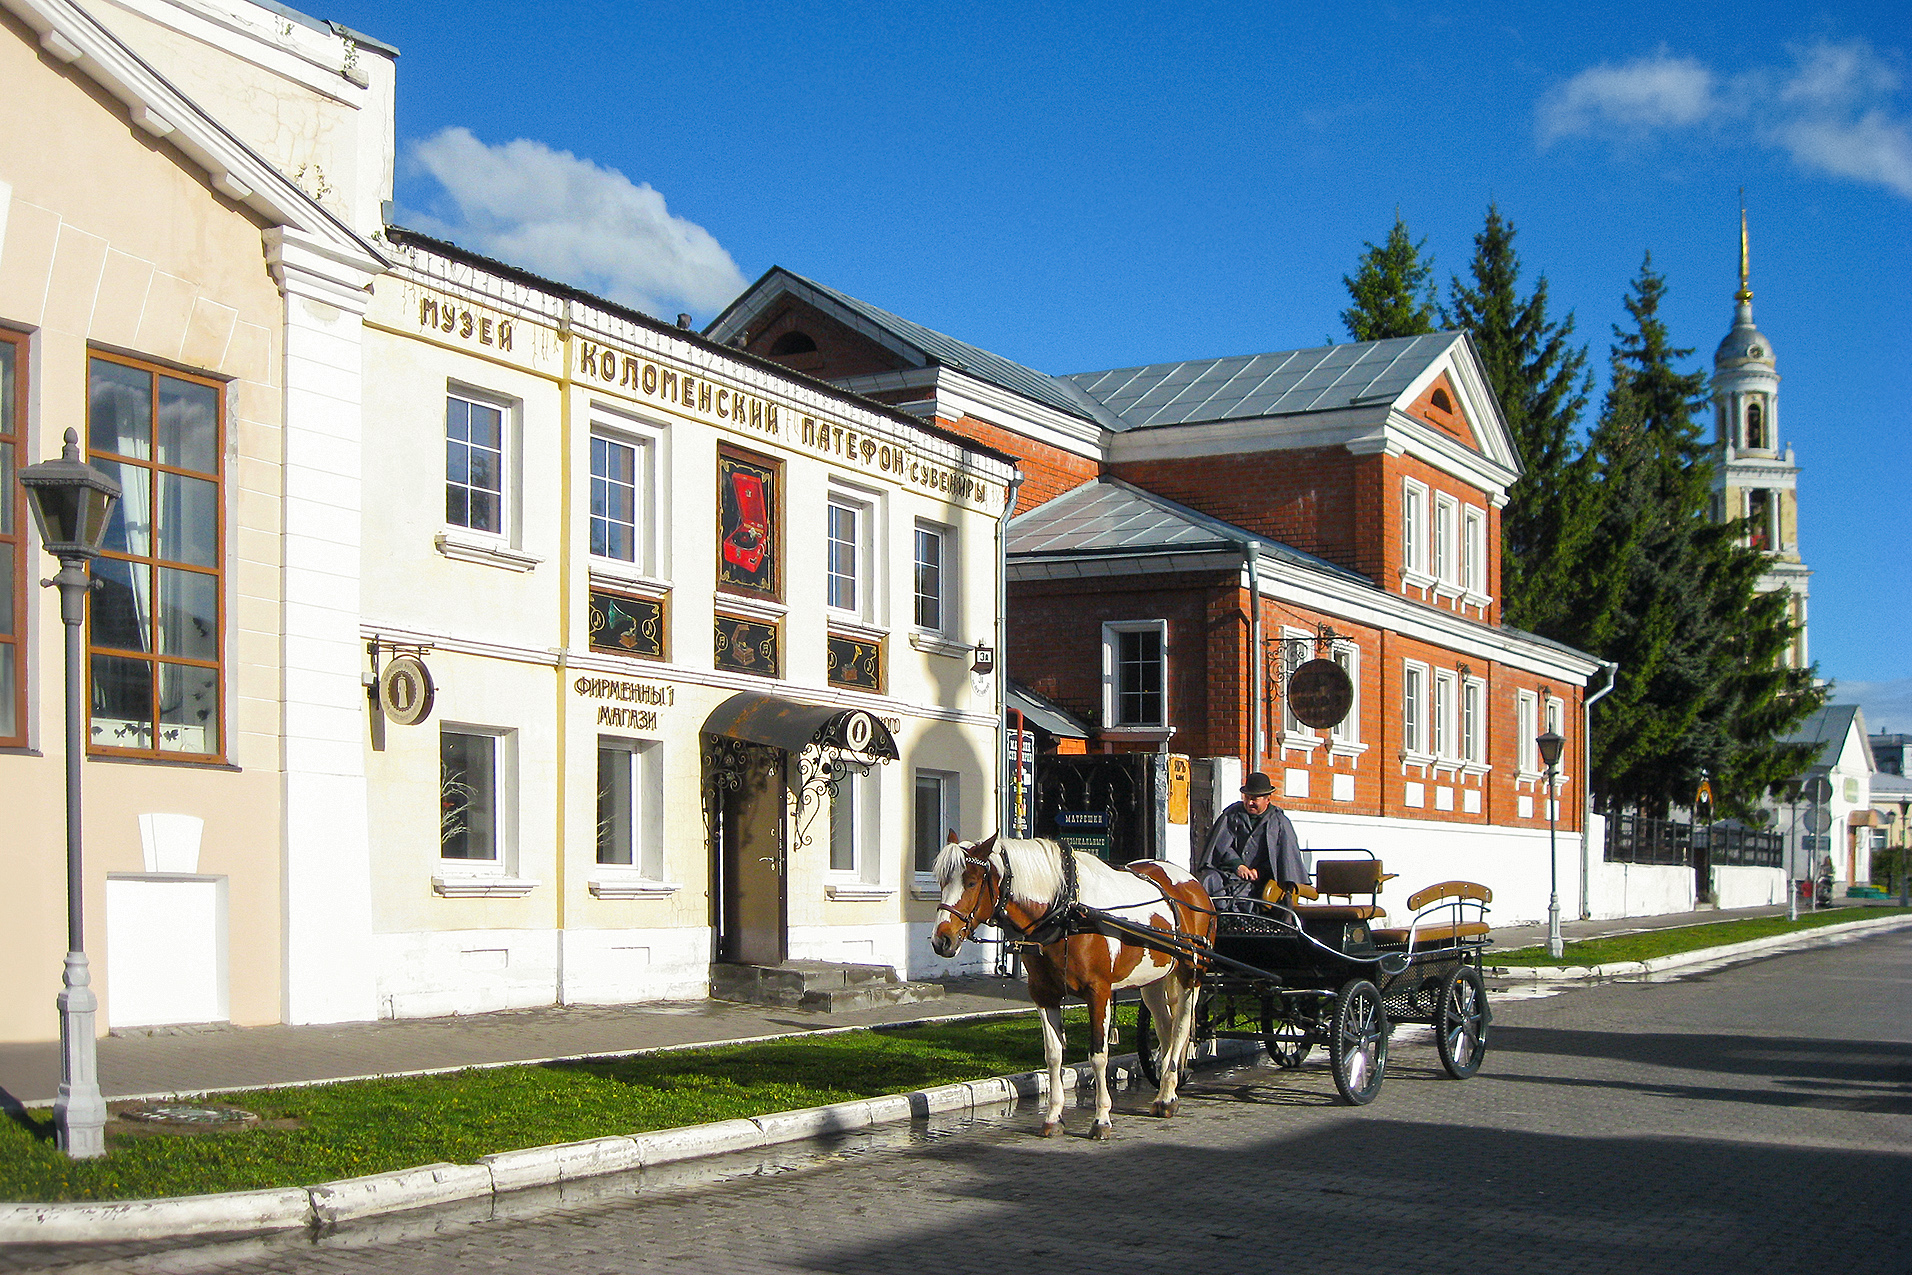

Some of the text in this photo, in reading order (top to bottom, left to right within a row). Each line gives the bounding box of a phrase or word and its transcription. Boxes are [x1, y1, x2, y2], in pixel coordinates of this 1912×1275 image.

[420, 297, 904, 475] МУЗЕЙ КОЛОМЕНСКИЙ ПАТЕФОН
[910, 461, 986, 503] СУВЕНИРЫ
[1065, 814, 1103, 824] МАТРЕШКИ
